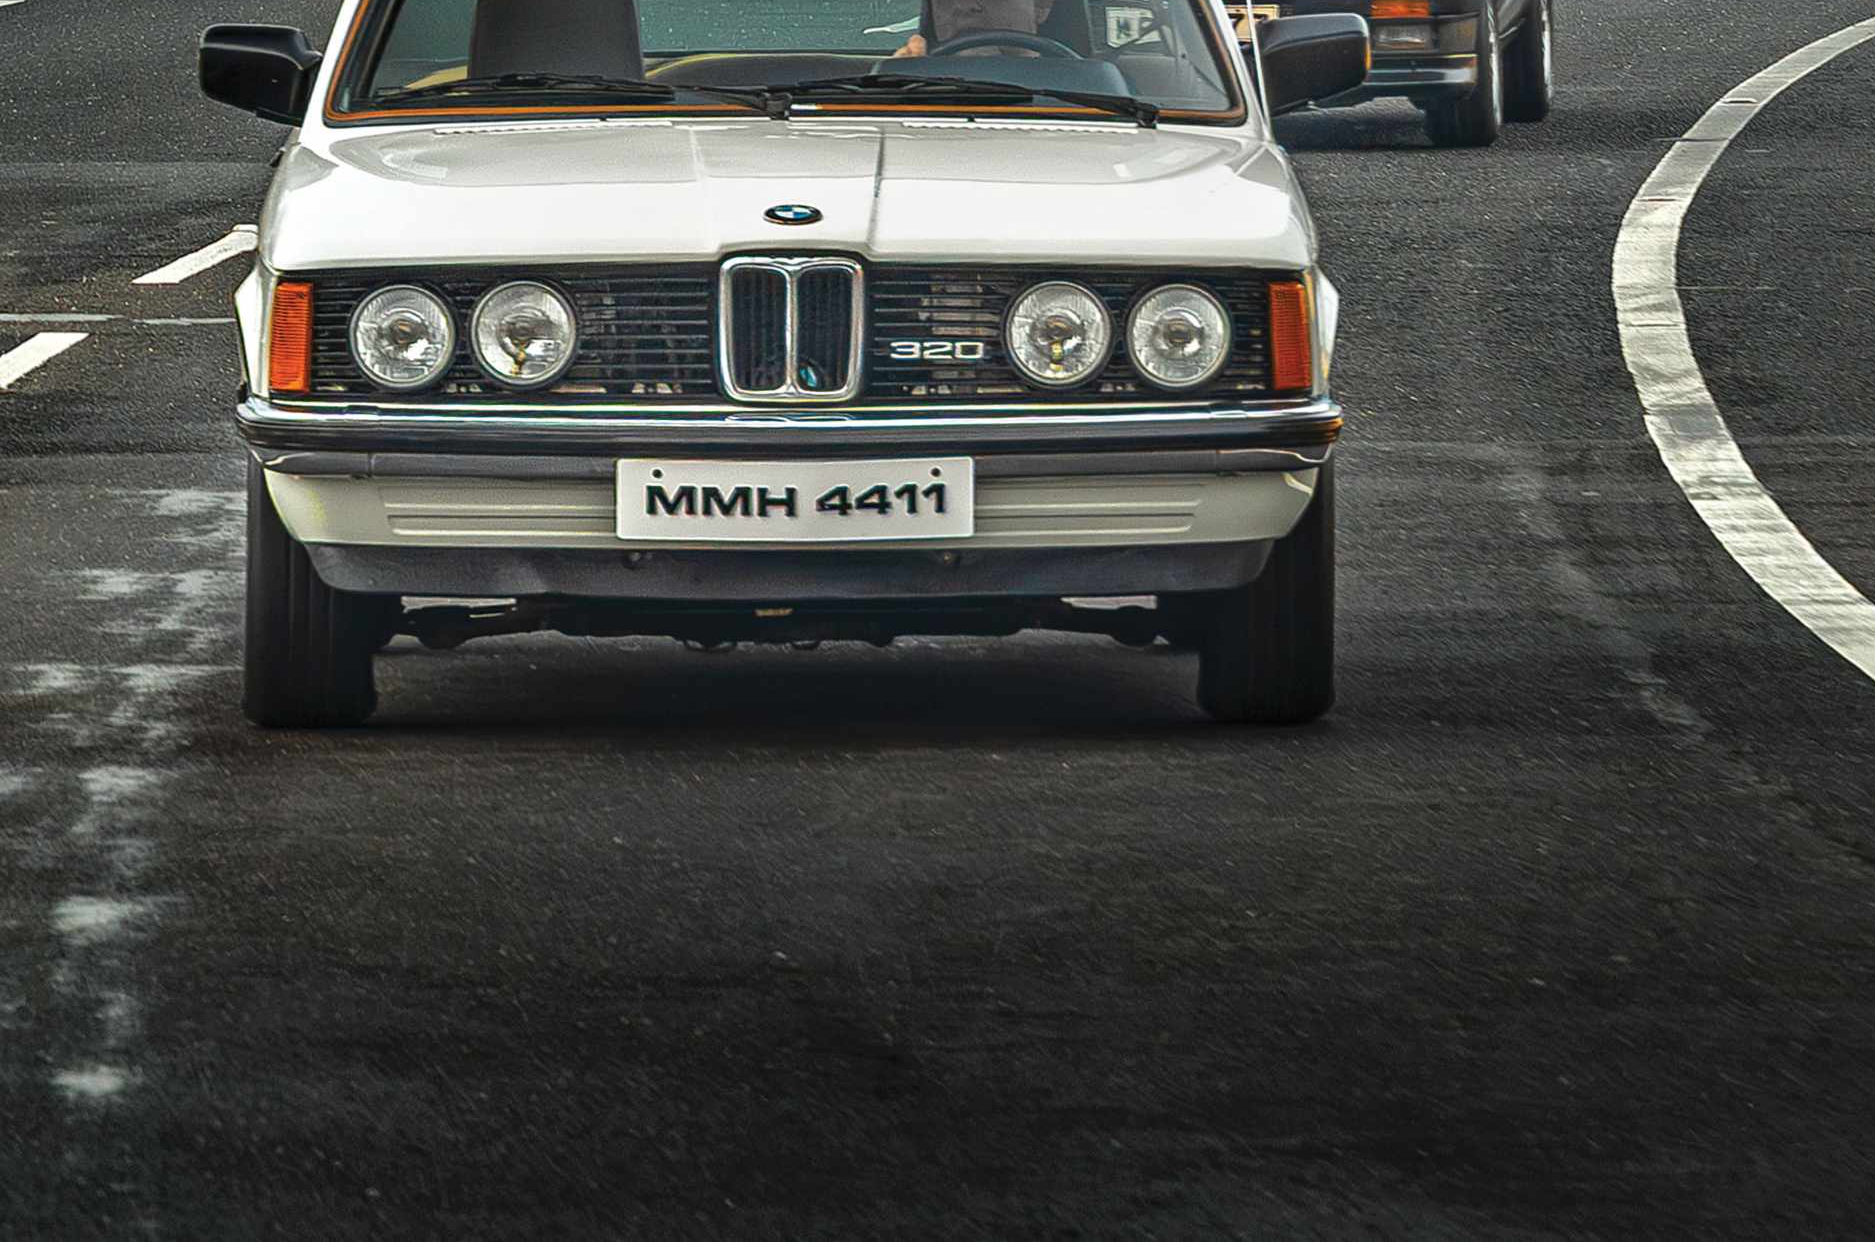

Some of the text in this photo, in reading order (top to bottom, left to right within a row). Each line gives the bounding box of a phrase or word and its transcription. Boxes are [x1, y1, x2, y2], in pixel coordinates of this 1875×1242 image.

[889, 341, 984, 360] 320
[645, 482, 947, 518] MMH 4411
